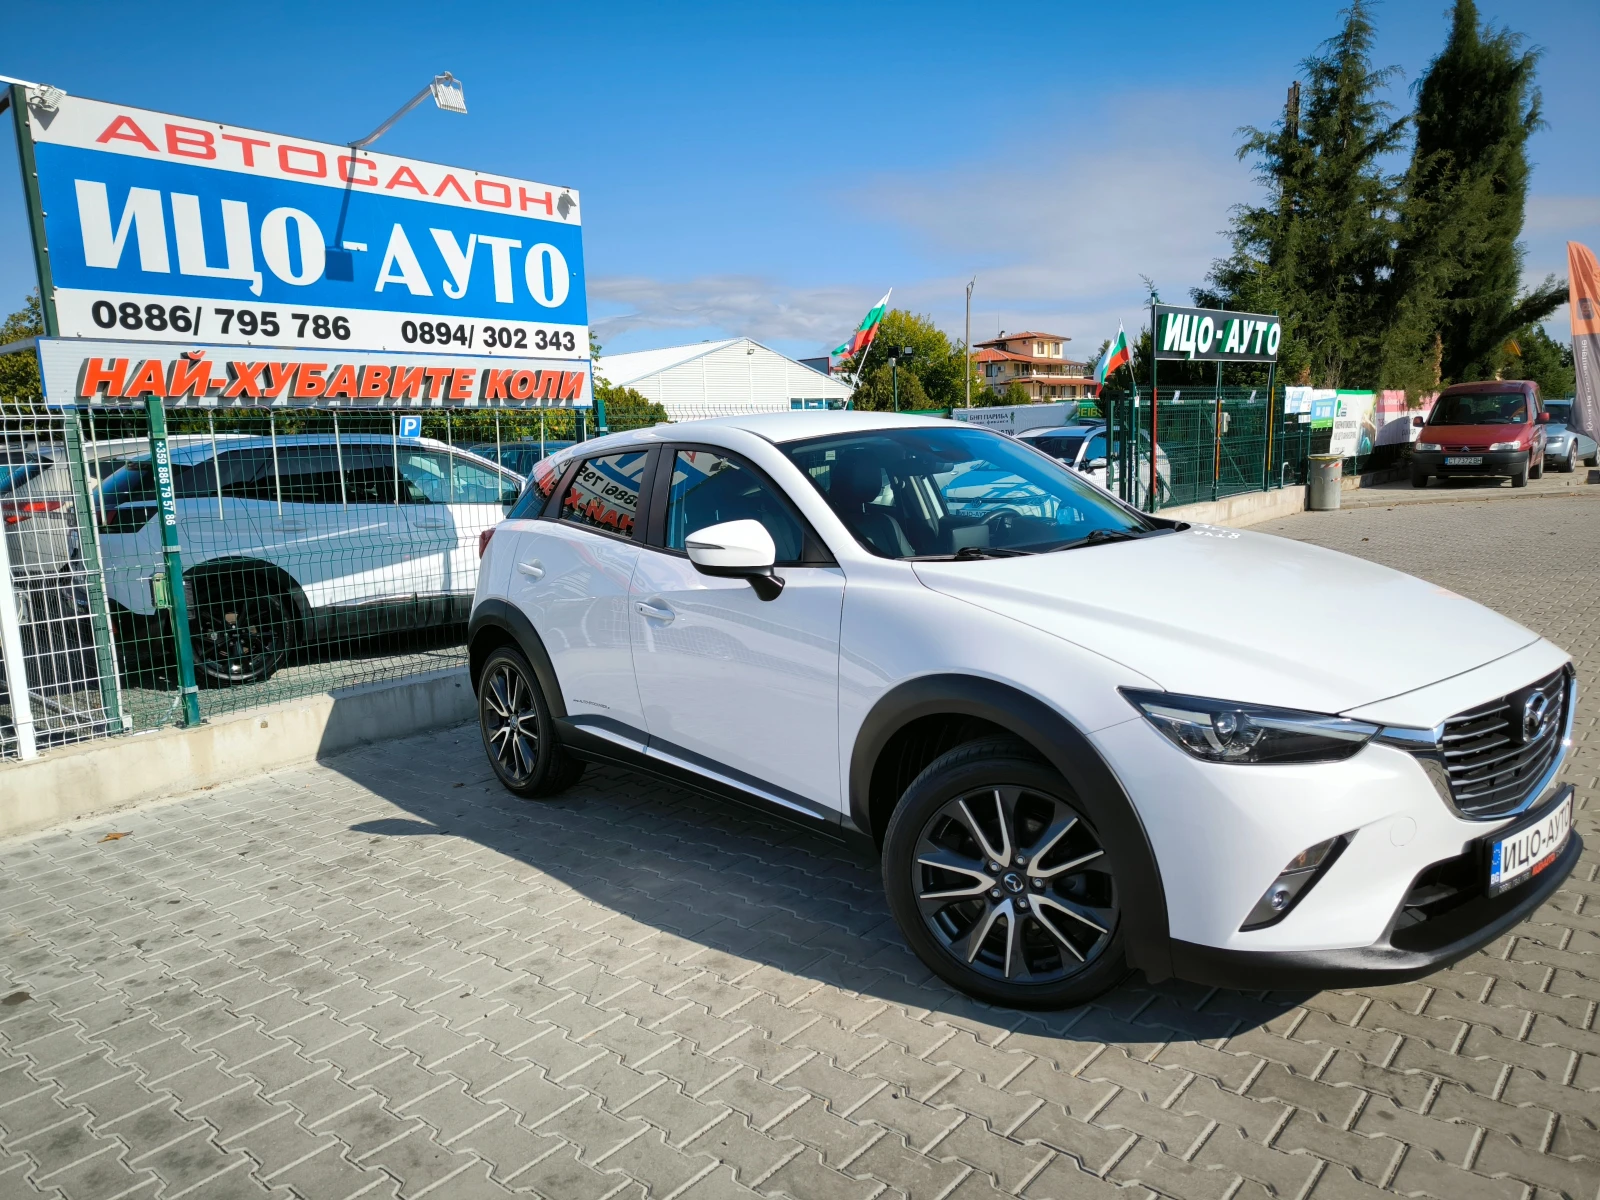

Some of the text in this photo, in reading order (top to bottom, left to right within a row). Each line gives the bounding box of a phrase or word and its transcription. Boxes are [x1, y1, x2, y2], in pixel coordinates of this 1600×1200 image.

[95, 115, 553, 216] АВТОСАЛОН
[74, 179, 570, 308] ИЦО-АУТО
[91, 300, 351, 341] 0886/ 795 786
[401, 320, 576, 351] 0894/ 302 343
[1163, 313, 1280, 359] ИЦО-АУТО
[80, 351, 584, 401] НАЙ-ХУБАВИТЕ КОЛИ
[156, 441, 176, 526] +359 886 79 57 86
[1504, 801, 1570, 874] ИЦО-АУТО
[1490, 872, 1500, 884] BG
